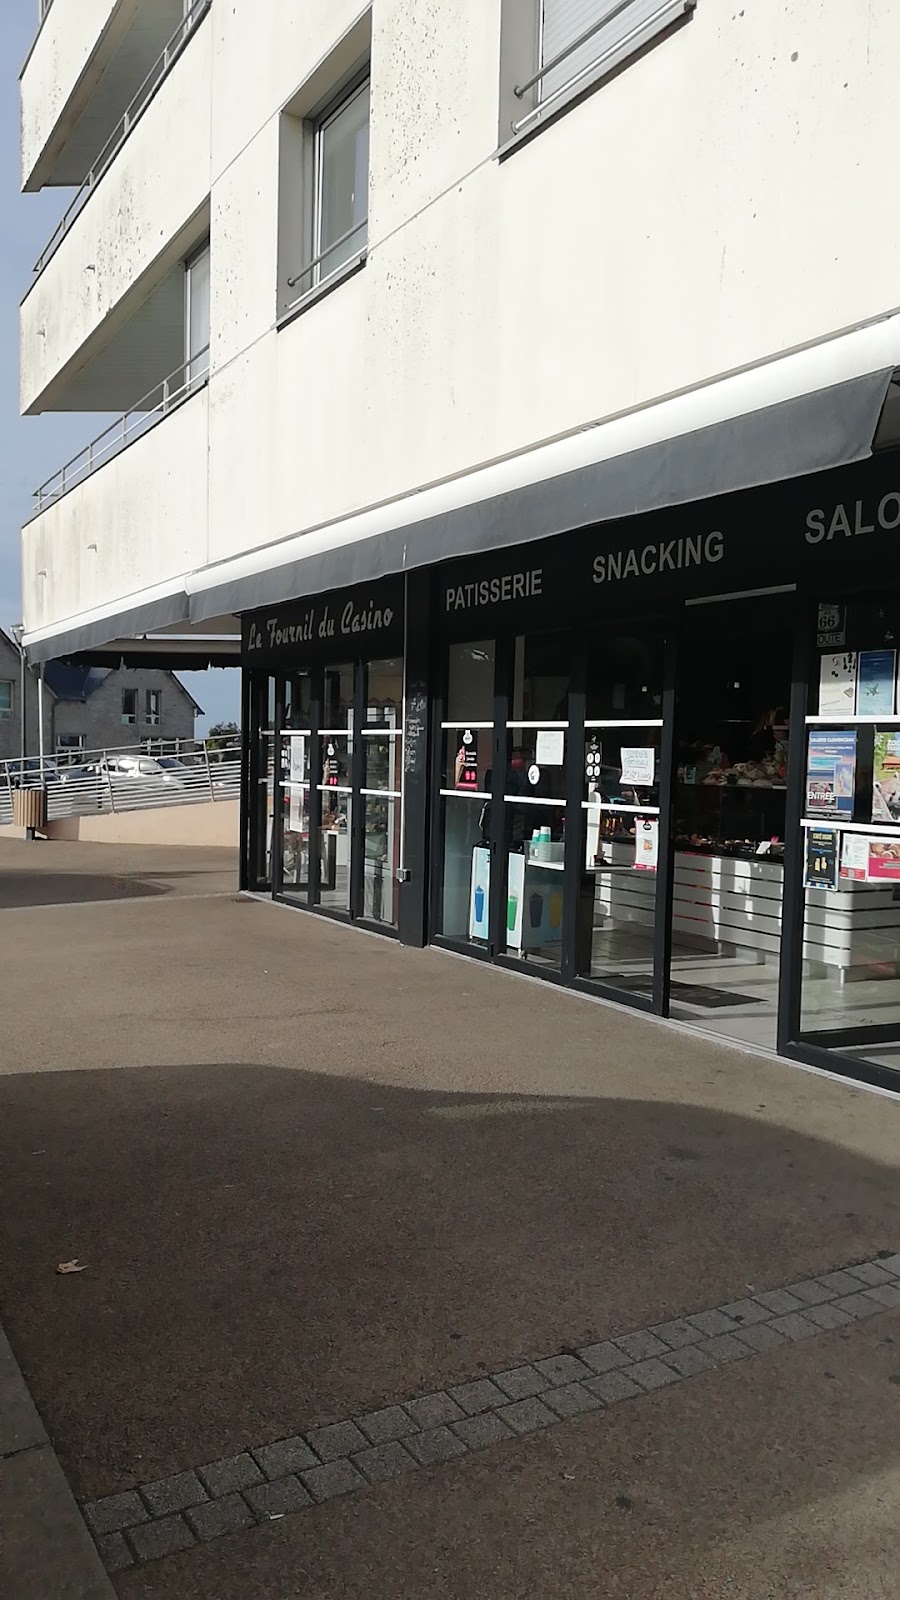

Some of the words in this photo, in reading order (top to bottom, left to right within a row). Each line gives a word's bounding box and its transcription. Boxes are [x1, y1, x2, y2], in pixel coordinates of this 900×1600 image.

[593, 531, 724, 584] SNACKING
[446, 568, 543, 611] PATISSERIE
[248, 623, 262, 651] Le
[267, 609, 314, 648] Fournil
[318, 606, 335, 638] du
[341, 600, 393, 634] Casino
[819, 615, 836, 628] 66
